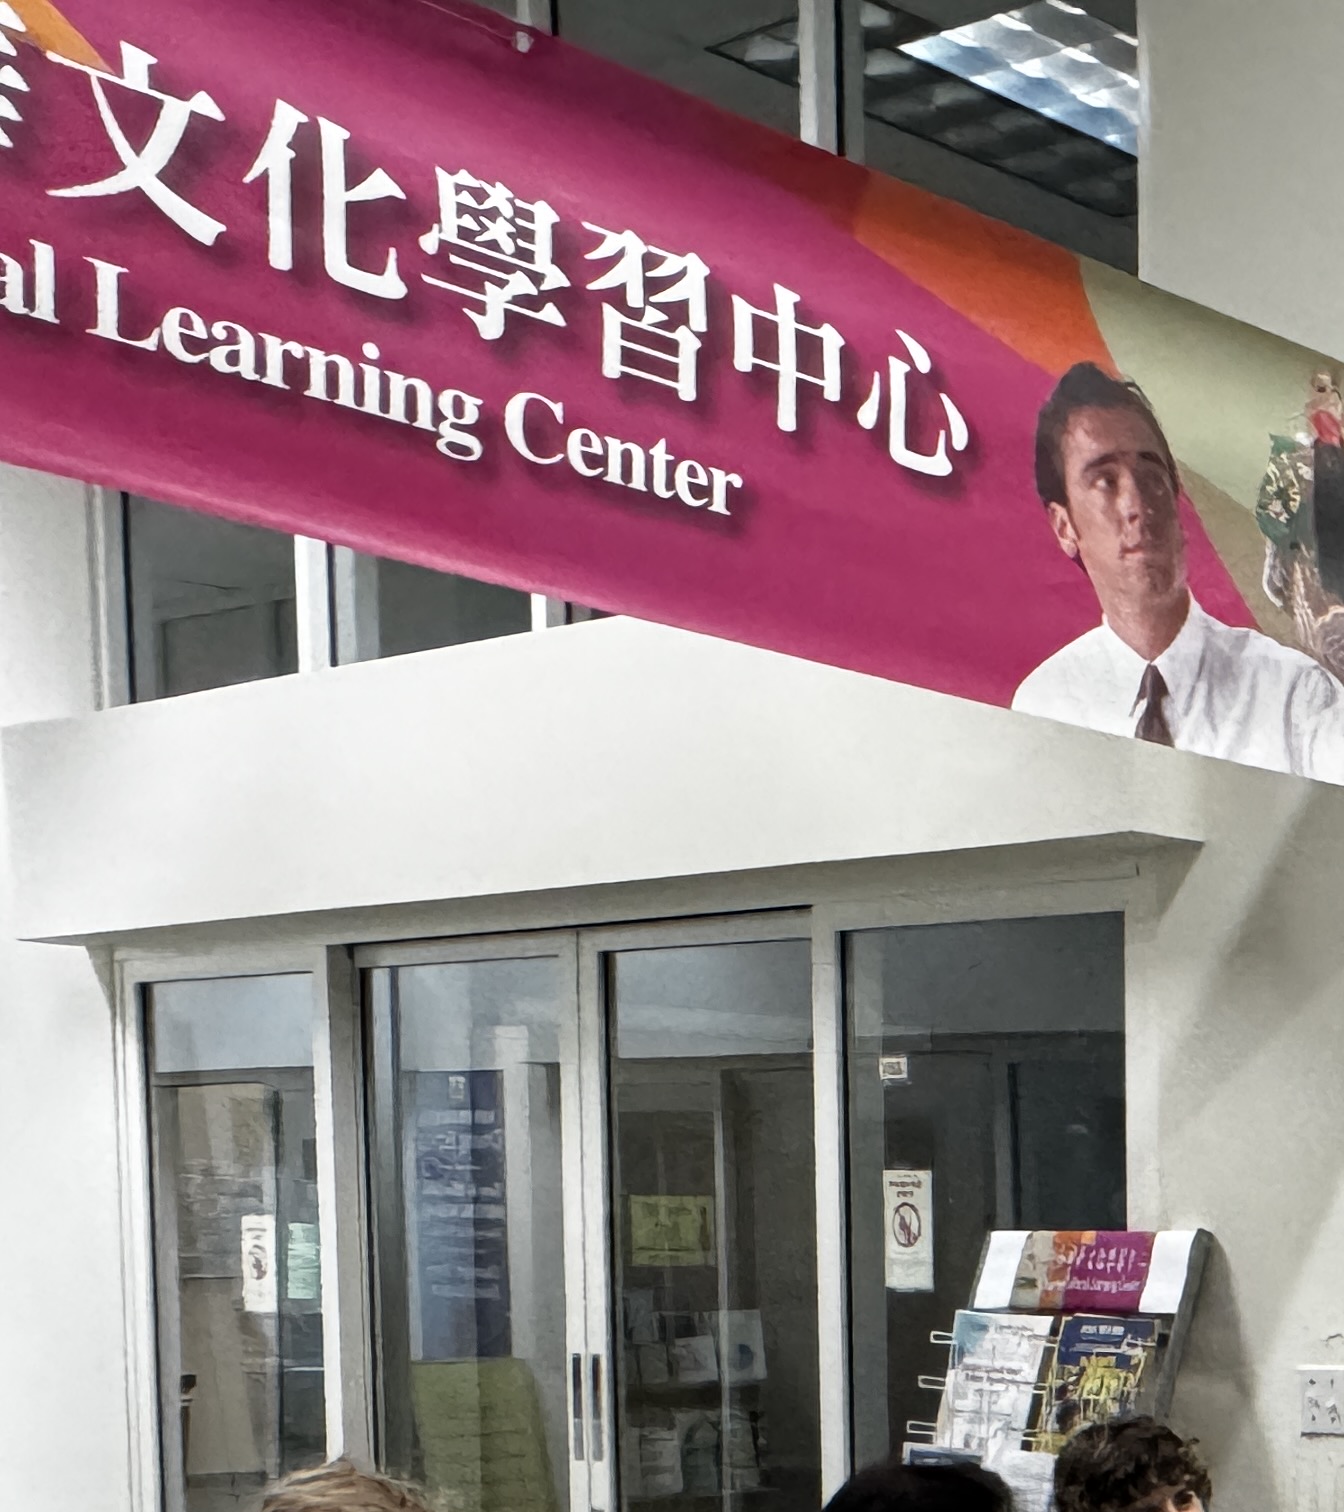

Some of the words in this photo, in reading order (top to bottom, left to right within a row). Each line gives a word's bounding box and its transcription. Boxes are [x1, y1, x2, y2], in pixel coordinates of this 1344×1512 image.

[0, 5, 970, 478] 文化學習中心
[83, 256, 482, 463] Learning
[504, 392, 743, 517] Center
